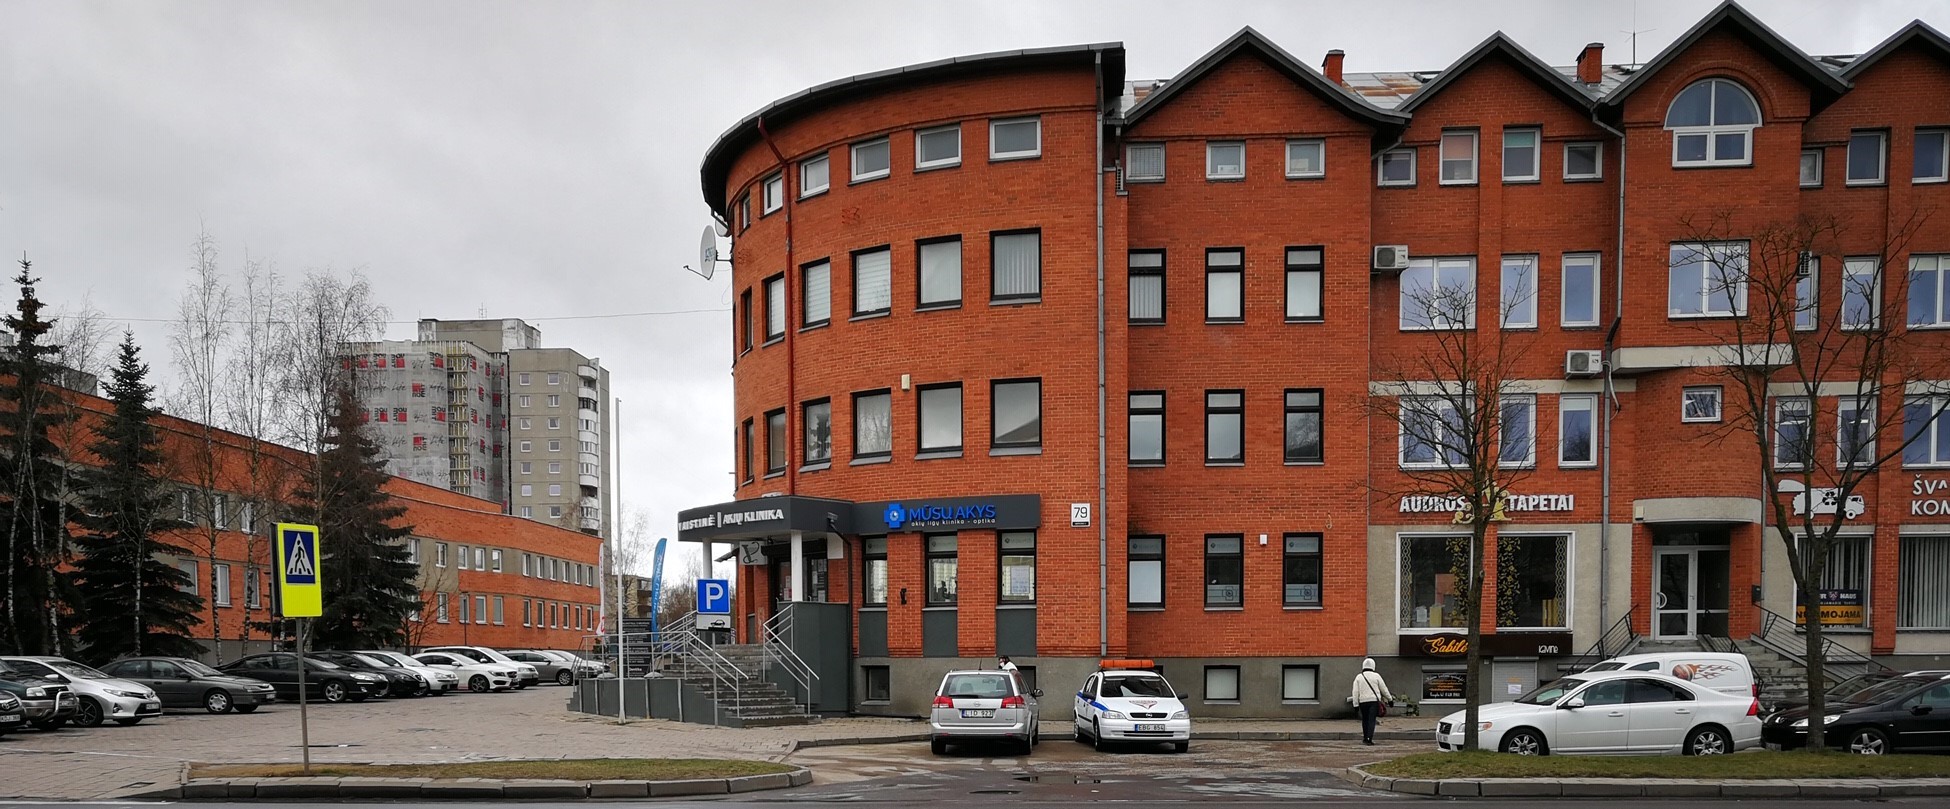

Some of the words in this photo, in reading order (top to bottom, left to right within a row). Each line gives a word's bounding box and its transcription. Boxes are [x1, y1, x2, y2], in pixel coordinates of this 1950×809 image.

[1508, 494, 1574, 511] TAPETAI
[744, 509, 784, 522] KLINIKA
[955, 504, 996, 519] AKYS
[1074, 506, 1088, 518] 79
[705, 582, 724, 610] P
